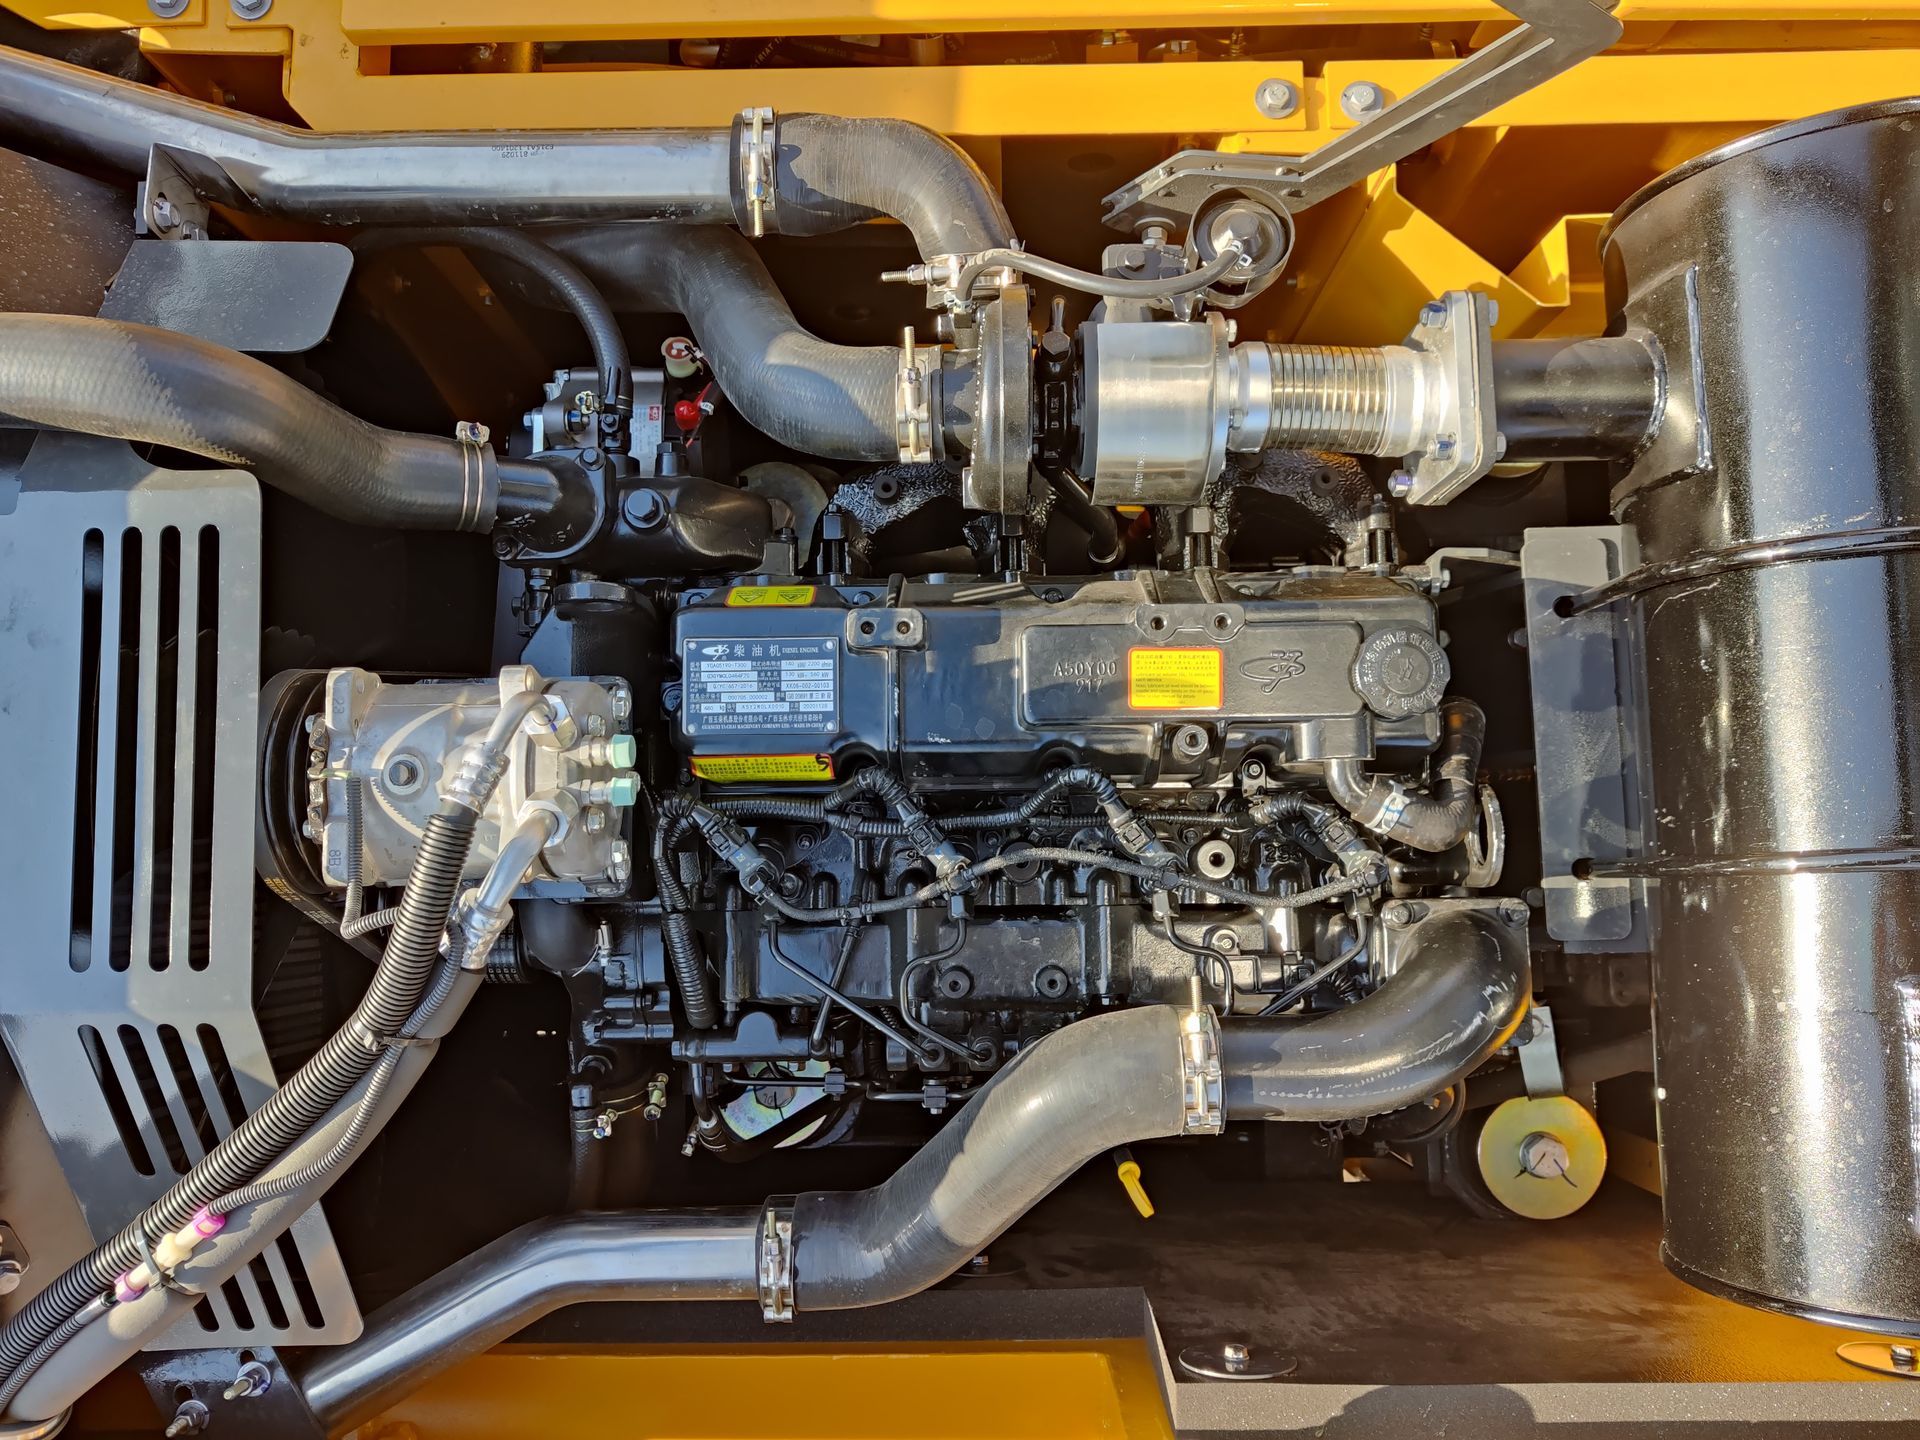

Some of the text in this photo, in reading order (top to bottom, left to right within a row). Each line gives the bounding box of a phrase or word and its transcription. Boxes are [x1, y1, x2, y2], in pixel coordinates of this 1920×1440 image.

[734, 644, 781, 657] 柴油机
[1076, 677, 1103, 694] 917
